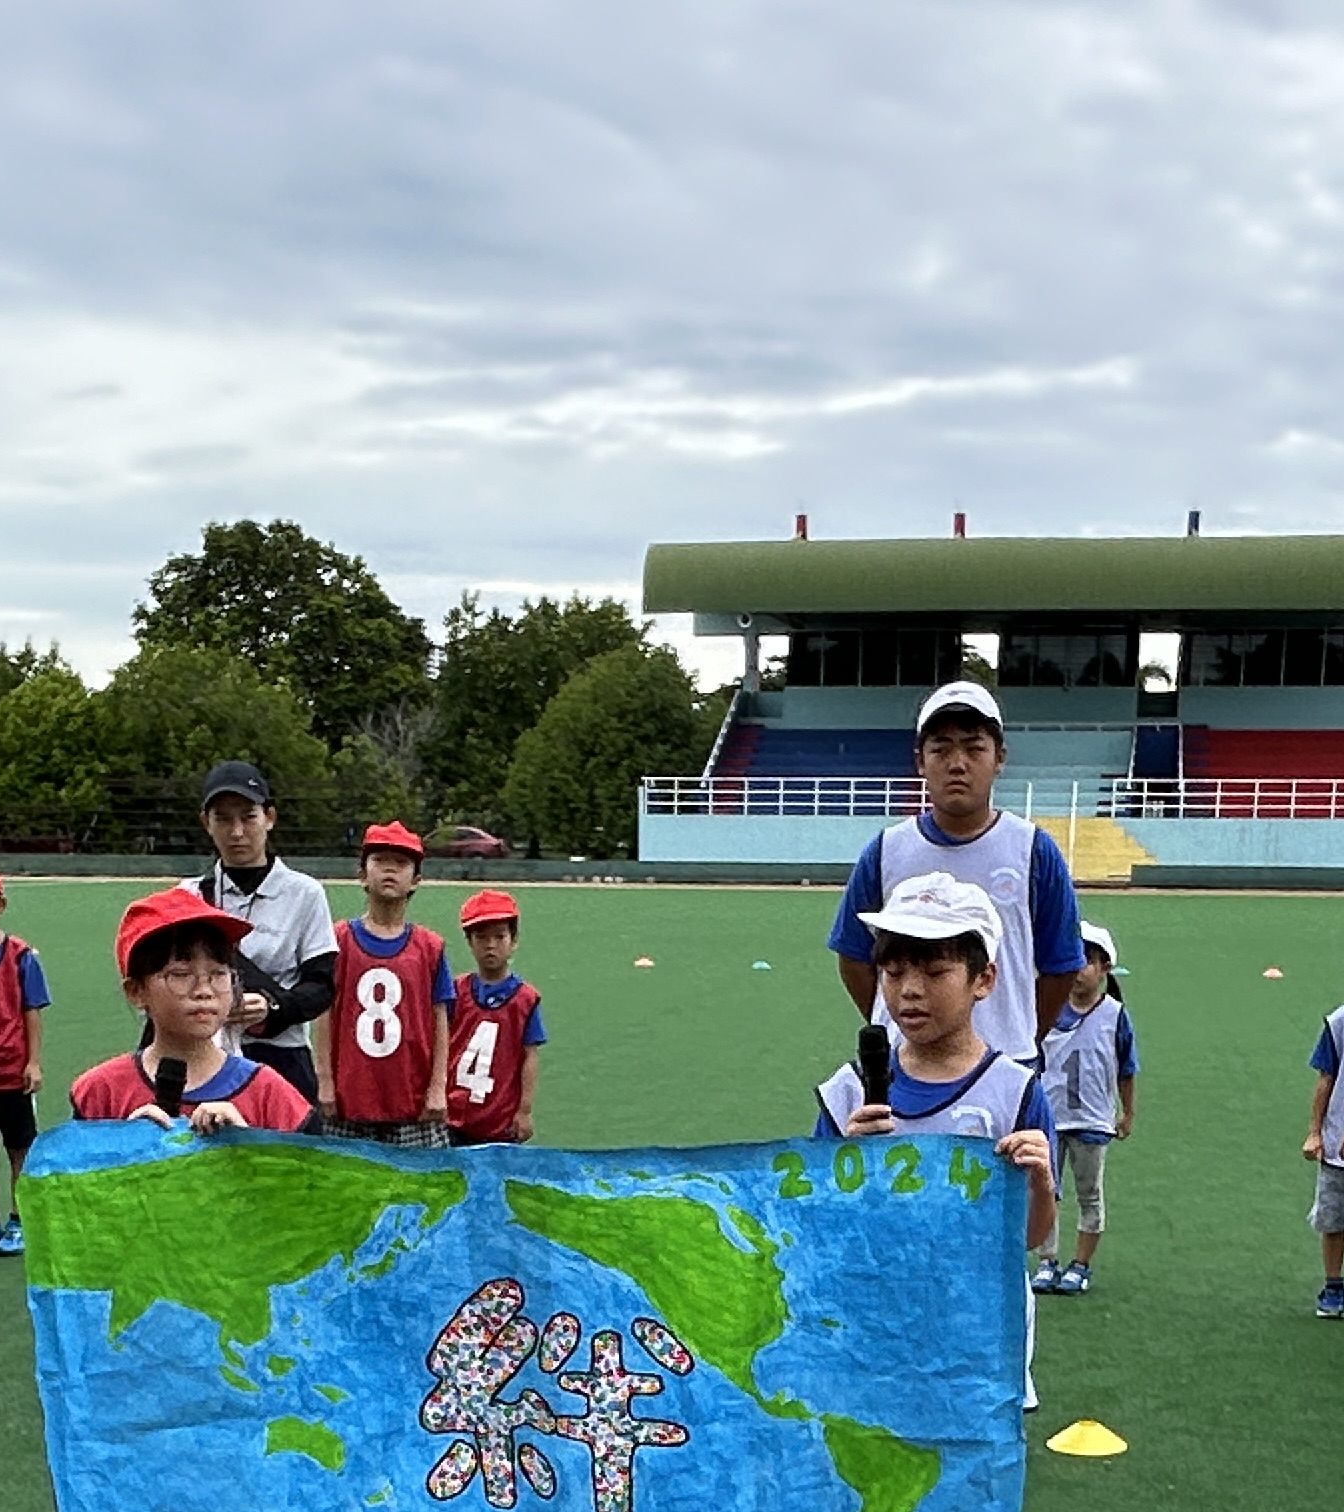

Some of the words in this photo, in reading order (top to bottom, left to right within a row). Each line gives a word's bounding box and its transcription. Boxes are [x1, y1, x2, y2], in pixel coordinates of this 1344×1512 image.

[356, 967, 401, 1057] 8
[456, 1021, 499, 1104] 4
[772, 1143, 991, 1200] 2024
